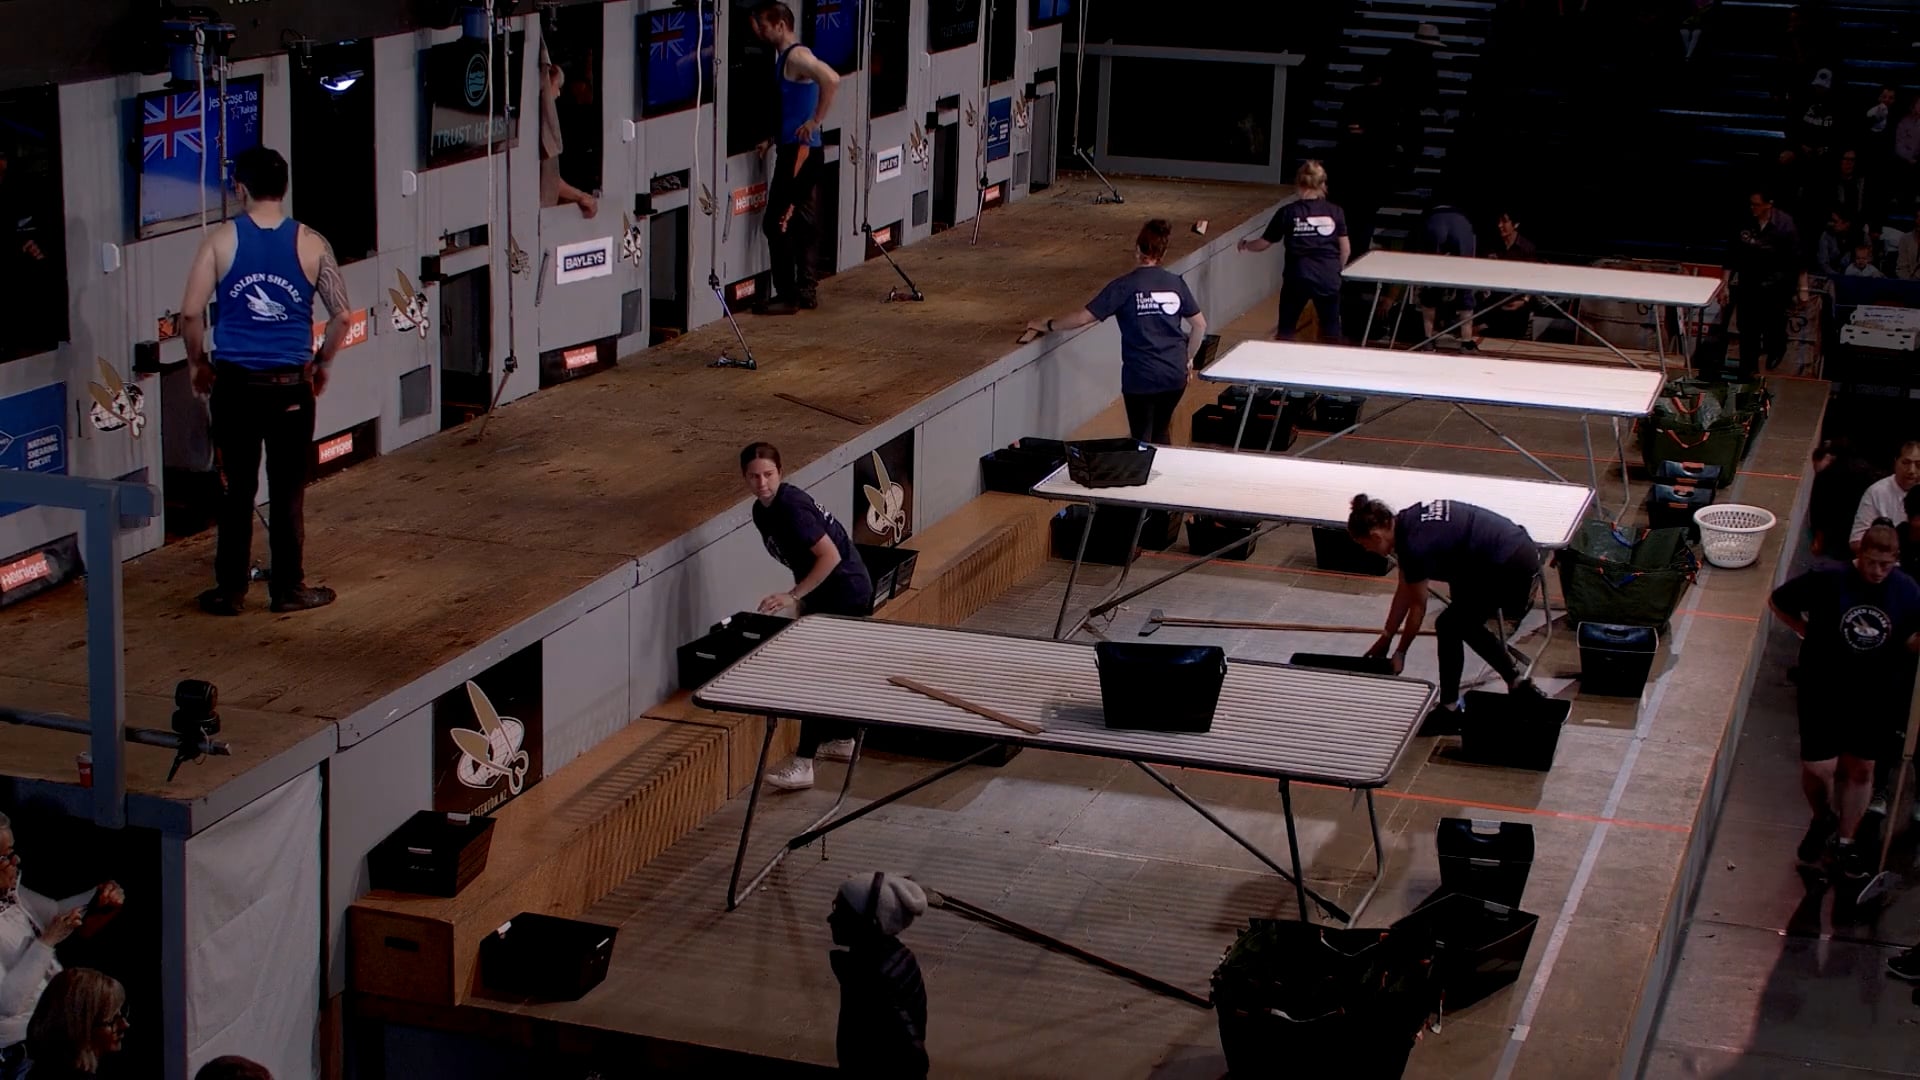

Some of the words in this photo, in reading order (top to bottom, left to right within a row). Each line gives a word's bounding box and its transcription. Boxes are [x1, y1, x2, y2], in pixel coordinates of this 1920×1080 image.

[435, 125, 472, 149] TRUST
[475, 117, 507, 140] HOUS
[565, 251, 605, 270] BAYLEYS
[229, 273, 267, 299] GOLDEN
[266, 273, 303, 304] SHEARS
